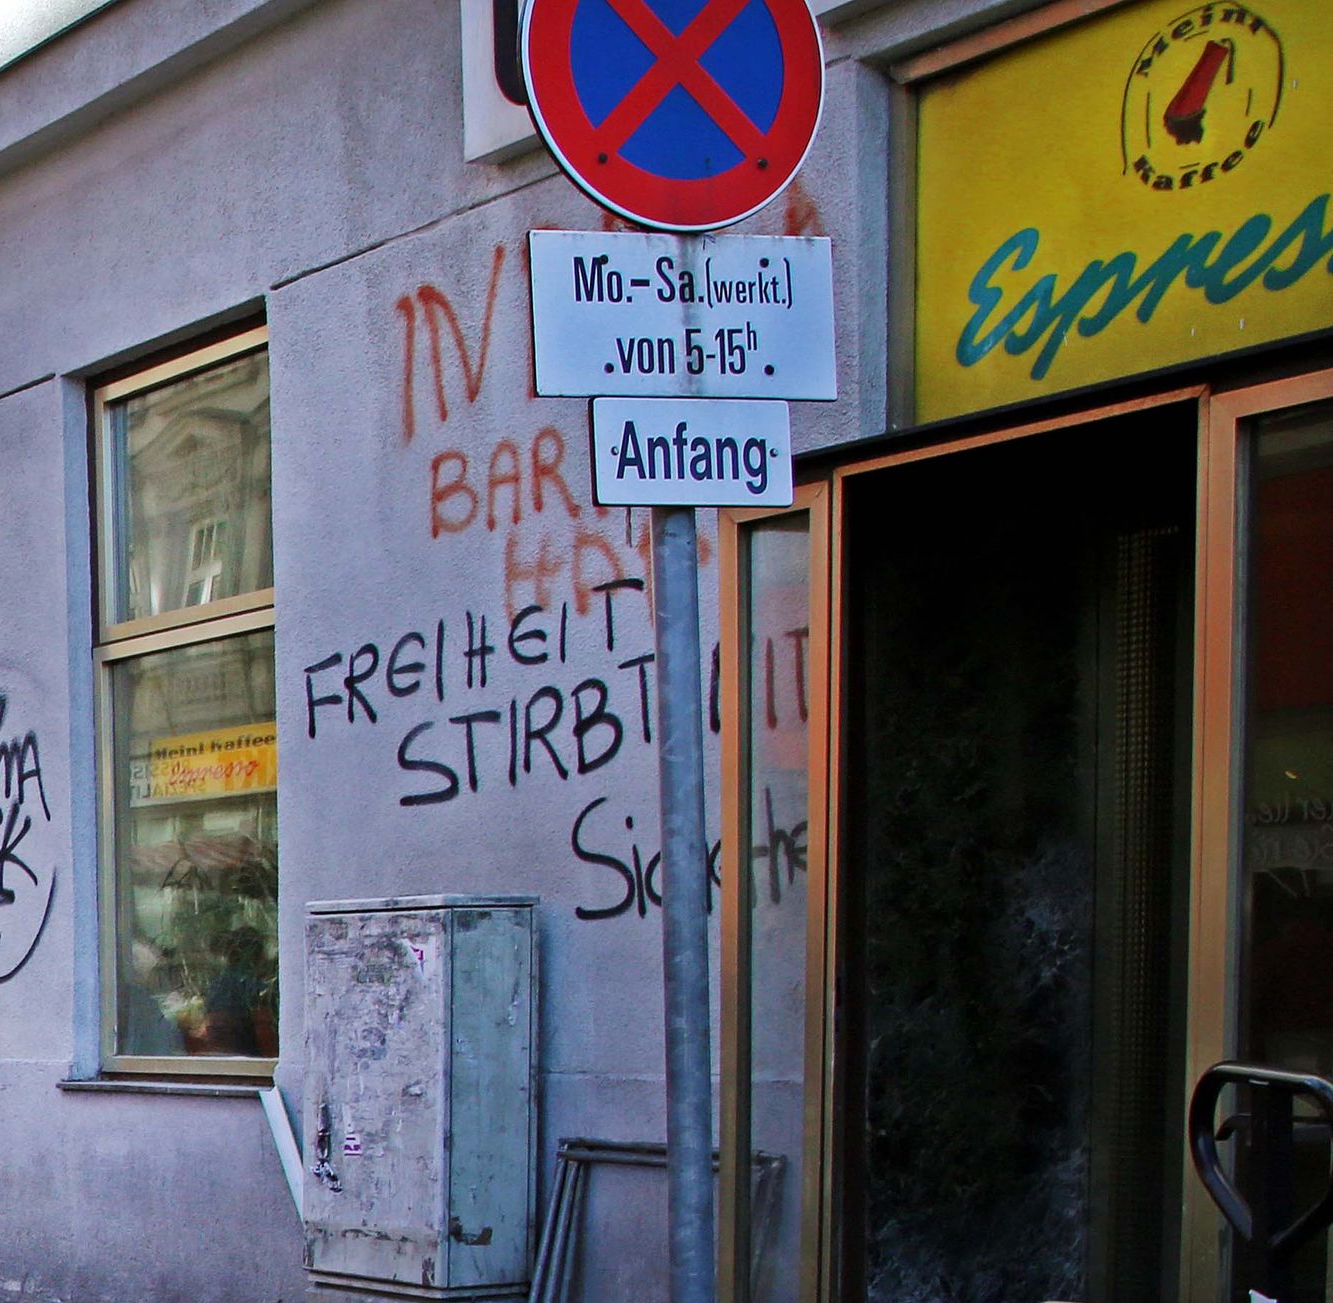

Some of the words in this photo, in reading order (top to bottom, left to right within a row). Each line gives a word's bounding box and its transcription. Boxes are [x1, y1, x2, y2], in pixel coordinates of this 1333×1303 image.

[617, 336, 675, 375] von
[955, 193, 1333, 380] Espres
[616, 420, 770, 494] Anfang
[304, 578, 644, 739] FREIHEIT
[398, 652, 655, 807] STIRBT
